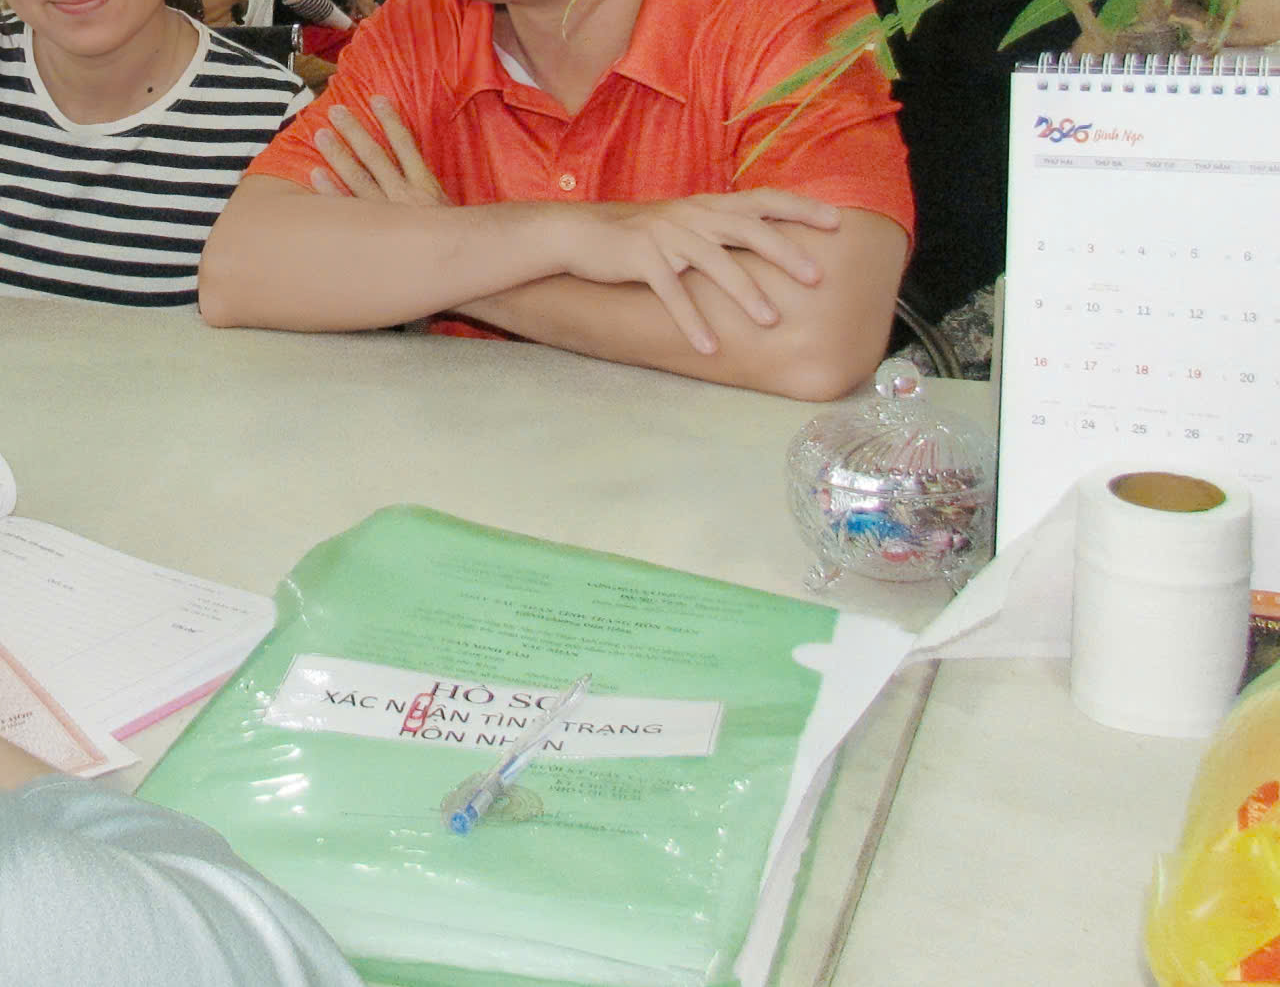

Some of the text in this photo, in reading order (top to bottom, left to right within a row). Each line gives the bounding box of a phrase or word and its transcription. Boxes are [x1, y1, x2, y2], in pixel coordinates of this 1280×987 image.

[1037, 241, 1252, 262] 2 3 4 5 6
[1035, 299, 1257, 322] 9 10 11 12 13
[1034, 357, 1255, 383] 16 17 18 19 20
[1031, 415, 1252, 444] 23 24 25 26 27
[432, 681, 495, 704] HỒ
[324, 686, 378, 709] XÁC
[480, 712, 536, 729] TÌN
[561, 720, 663, 735] TRẠNG
[399, 726, 564, 752] HÔN NHN
